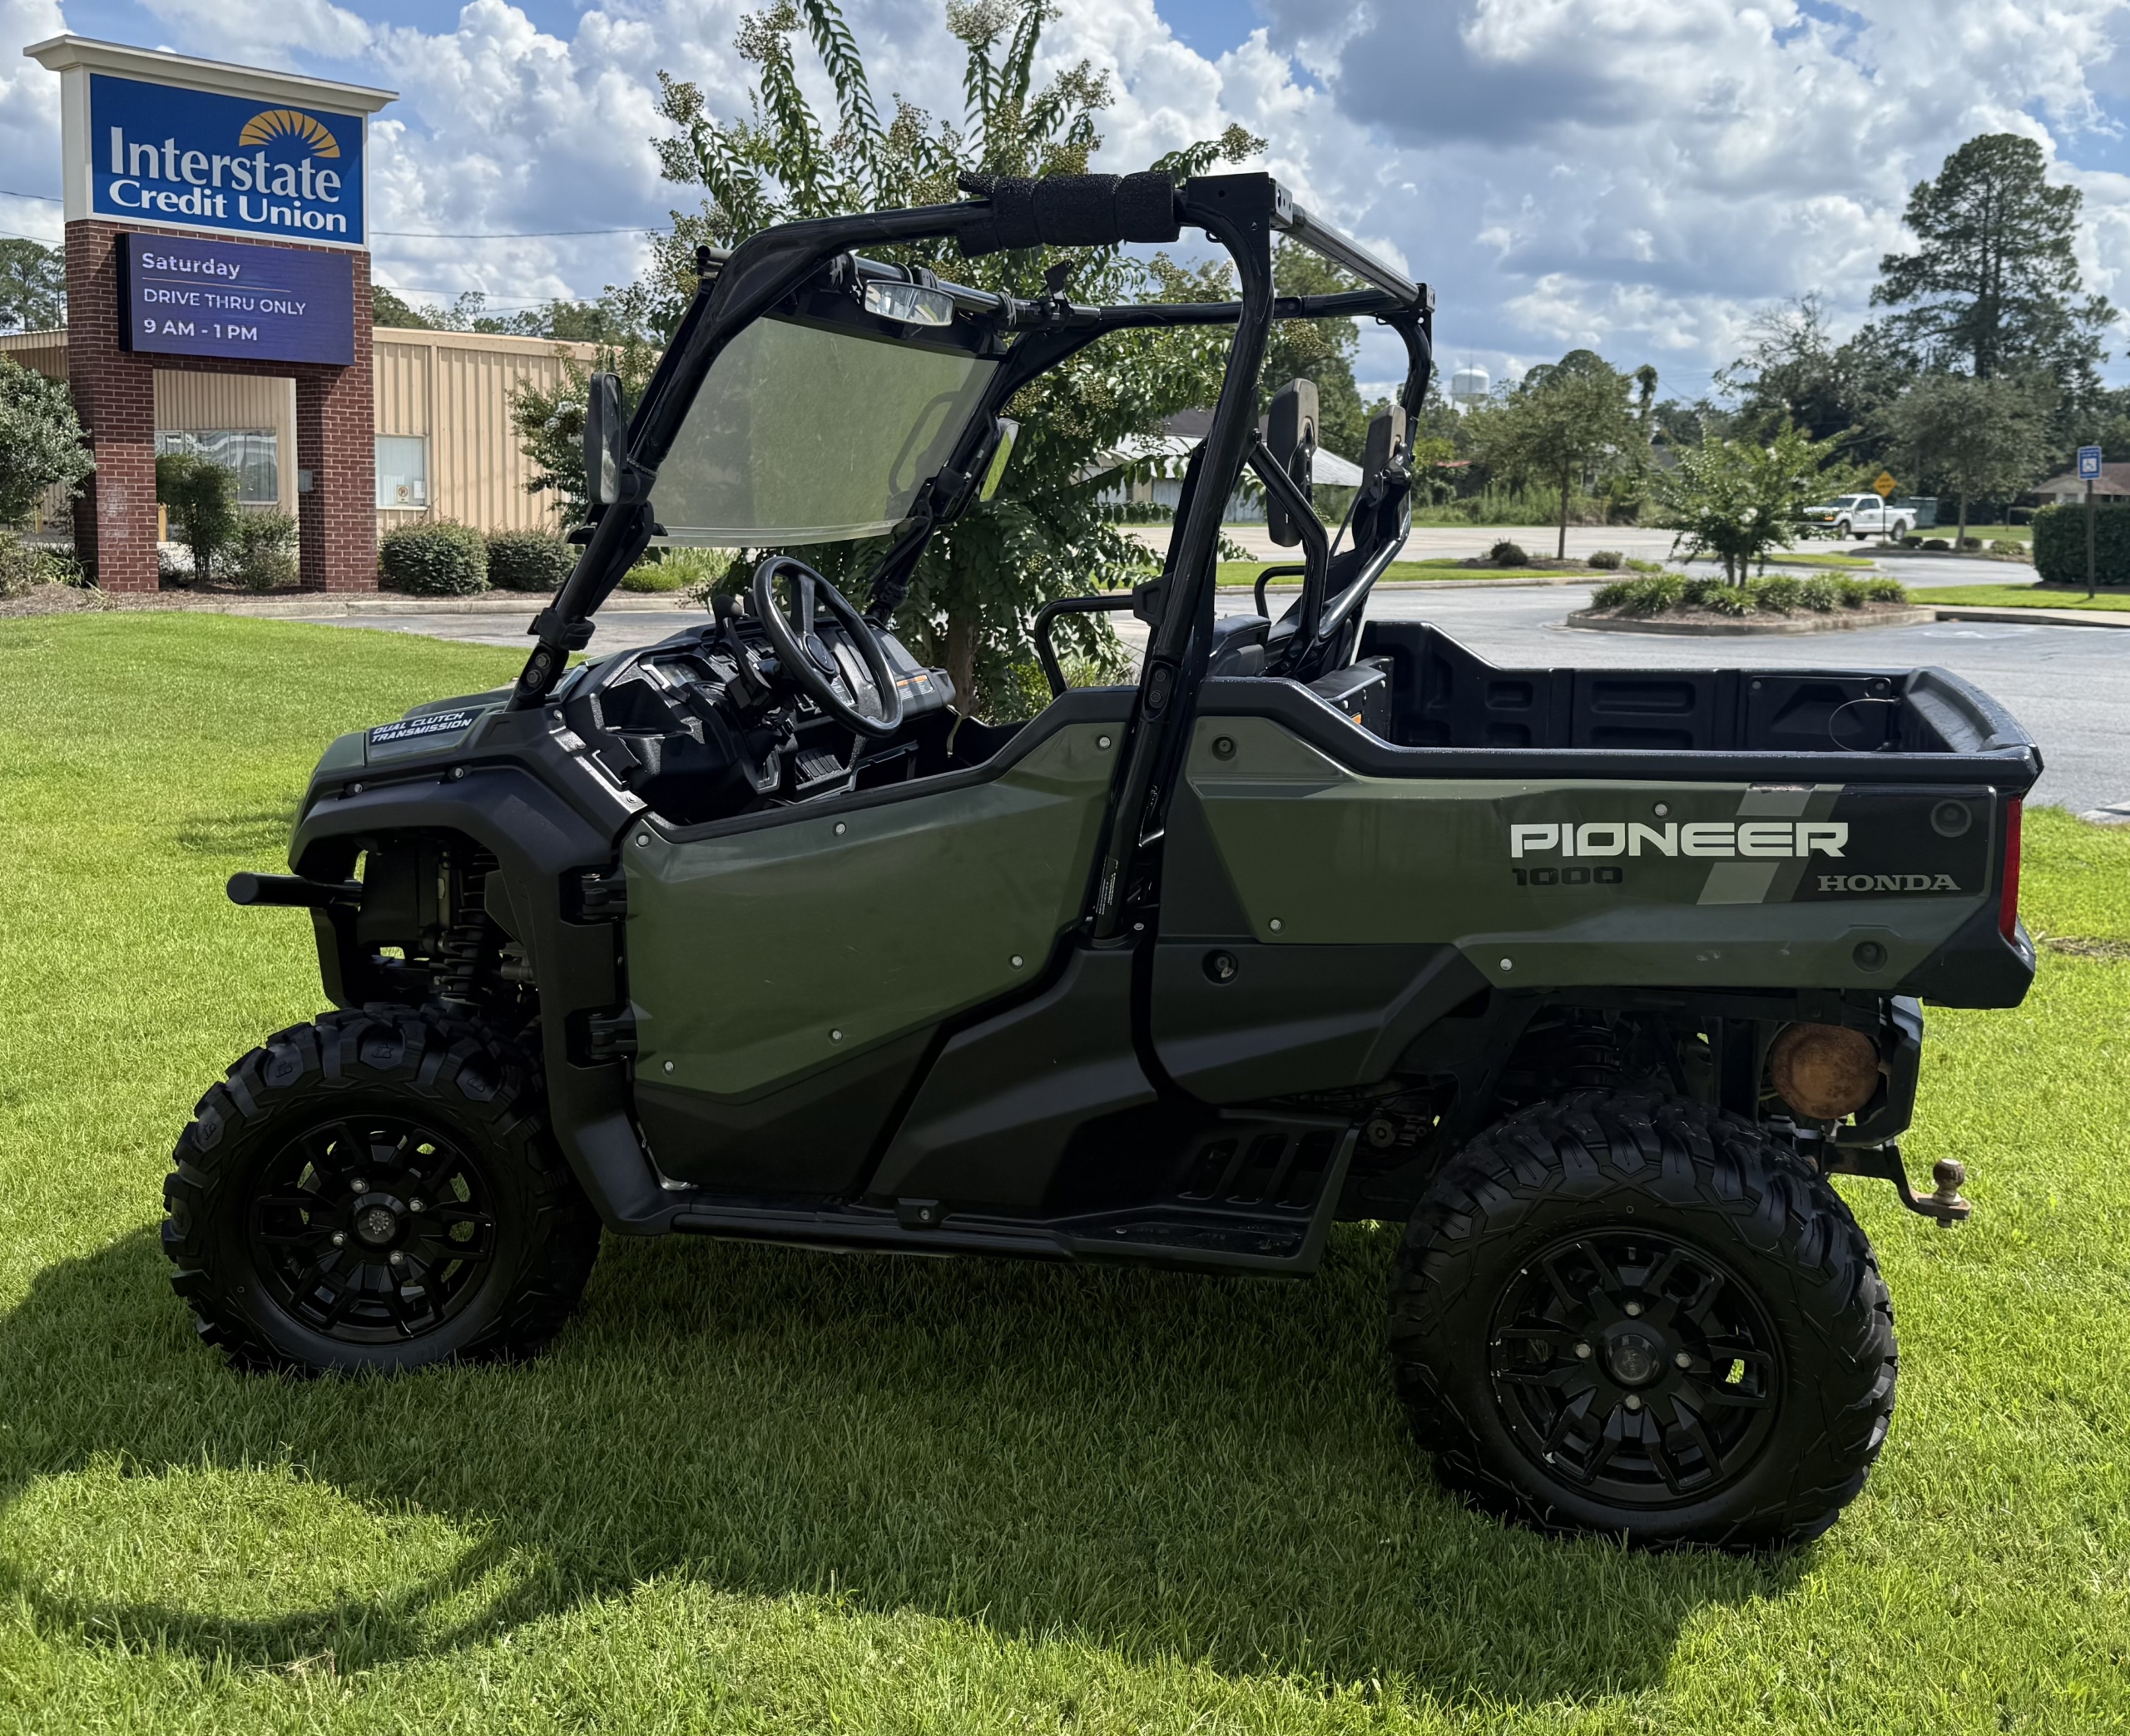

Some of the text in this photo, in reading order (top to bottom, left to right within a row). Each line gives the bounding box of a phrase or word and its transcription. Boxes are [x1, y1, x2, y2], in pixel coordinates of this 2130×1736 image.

[111, 126, 341, 202] Interstate
[109, 179, 346, 233] Credit Union
[141, 253, 240, 279] Saturday
[144, 289, 306, 315] DRIVE THRU ONLY
[144, 318, 156, 334] 9
[162, 319, 195, 336] AM
[213, 324, 221, 339] 1
[227, 324, 257, 341] PM
[372, 712, 465, 734] DUAL CLUTCH
[372, 719, 473, 743] TRANSMISSION
[1511, 822, 1849, 858] PIONEER
[1512, 866, 1622, 886] 1000
[1817, 873, 1961, 891] HONDA
